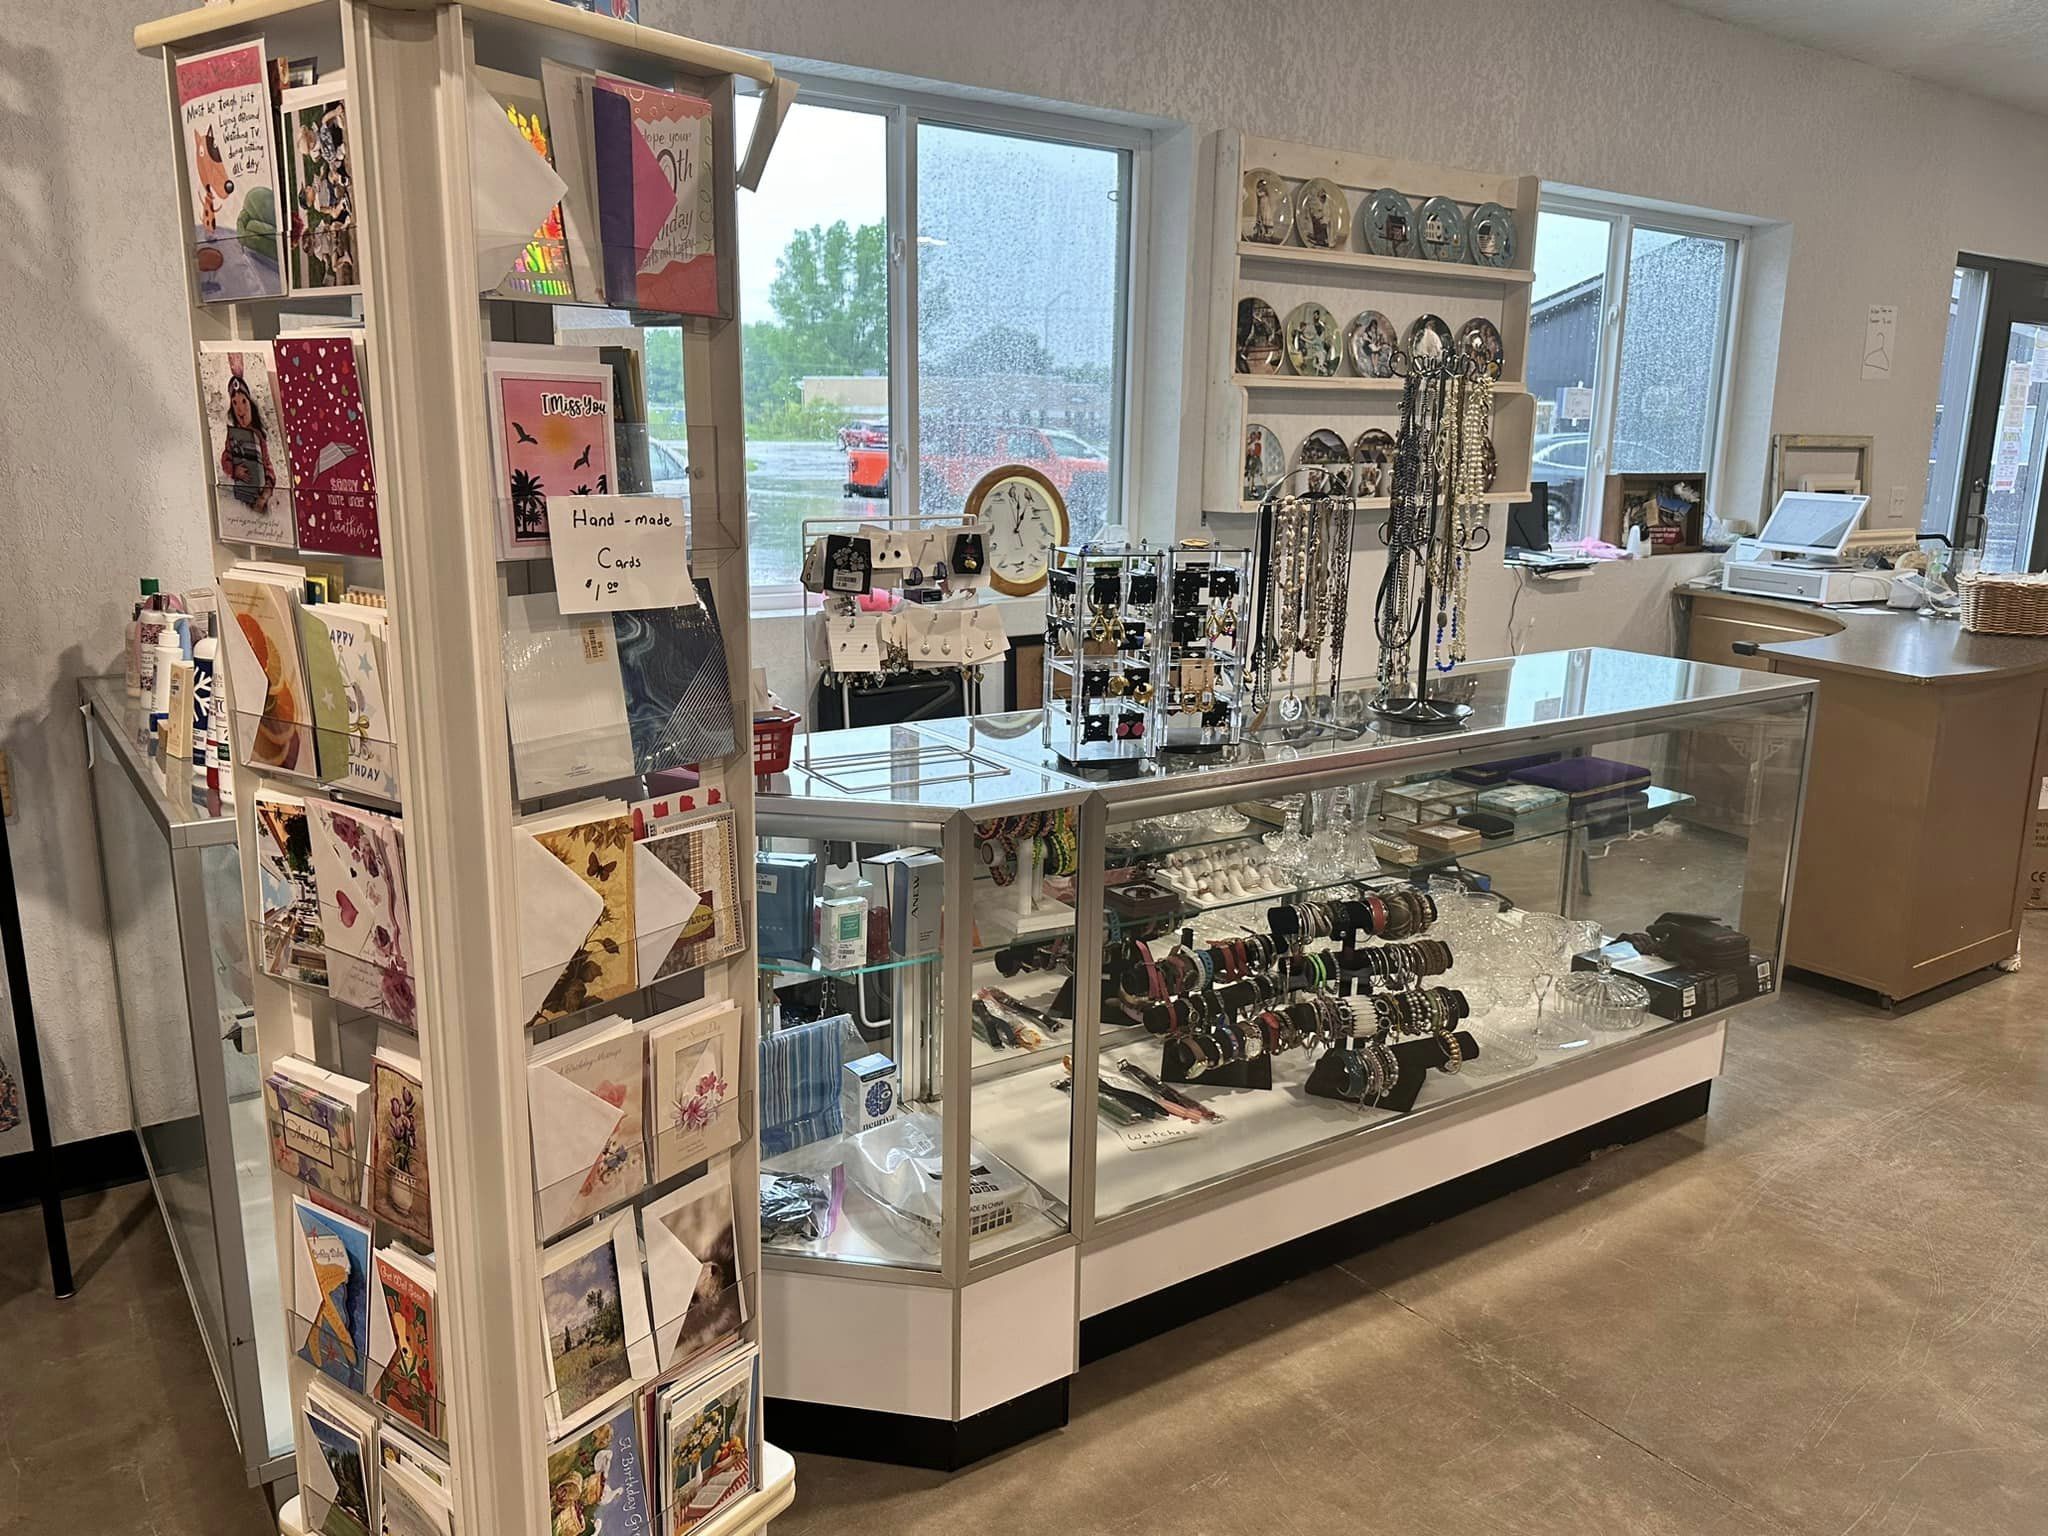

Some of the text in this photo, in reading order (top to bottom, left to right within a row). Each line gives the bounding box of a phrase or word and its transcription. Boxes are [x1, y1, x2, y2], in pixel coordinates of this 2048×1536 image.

[541, 394, 607, 417] I Miss You
[330, 478, 359, 492] SORRY
[330, 515, 368, 538] weather
[573, 508, 614, 528] Hand
[597, 547, 641, 569] Cards
[330, 629, 354, 647] APPY
[349, 762, 381, 782] THDAY
[1128, 1129, 1187, 1141] Watches
[621, 1452, 641, 1512] Birthday
